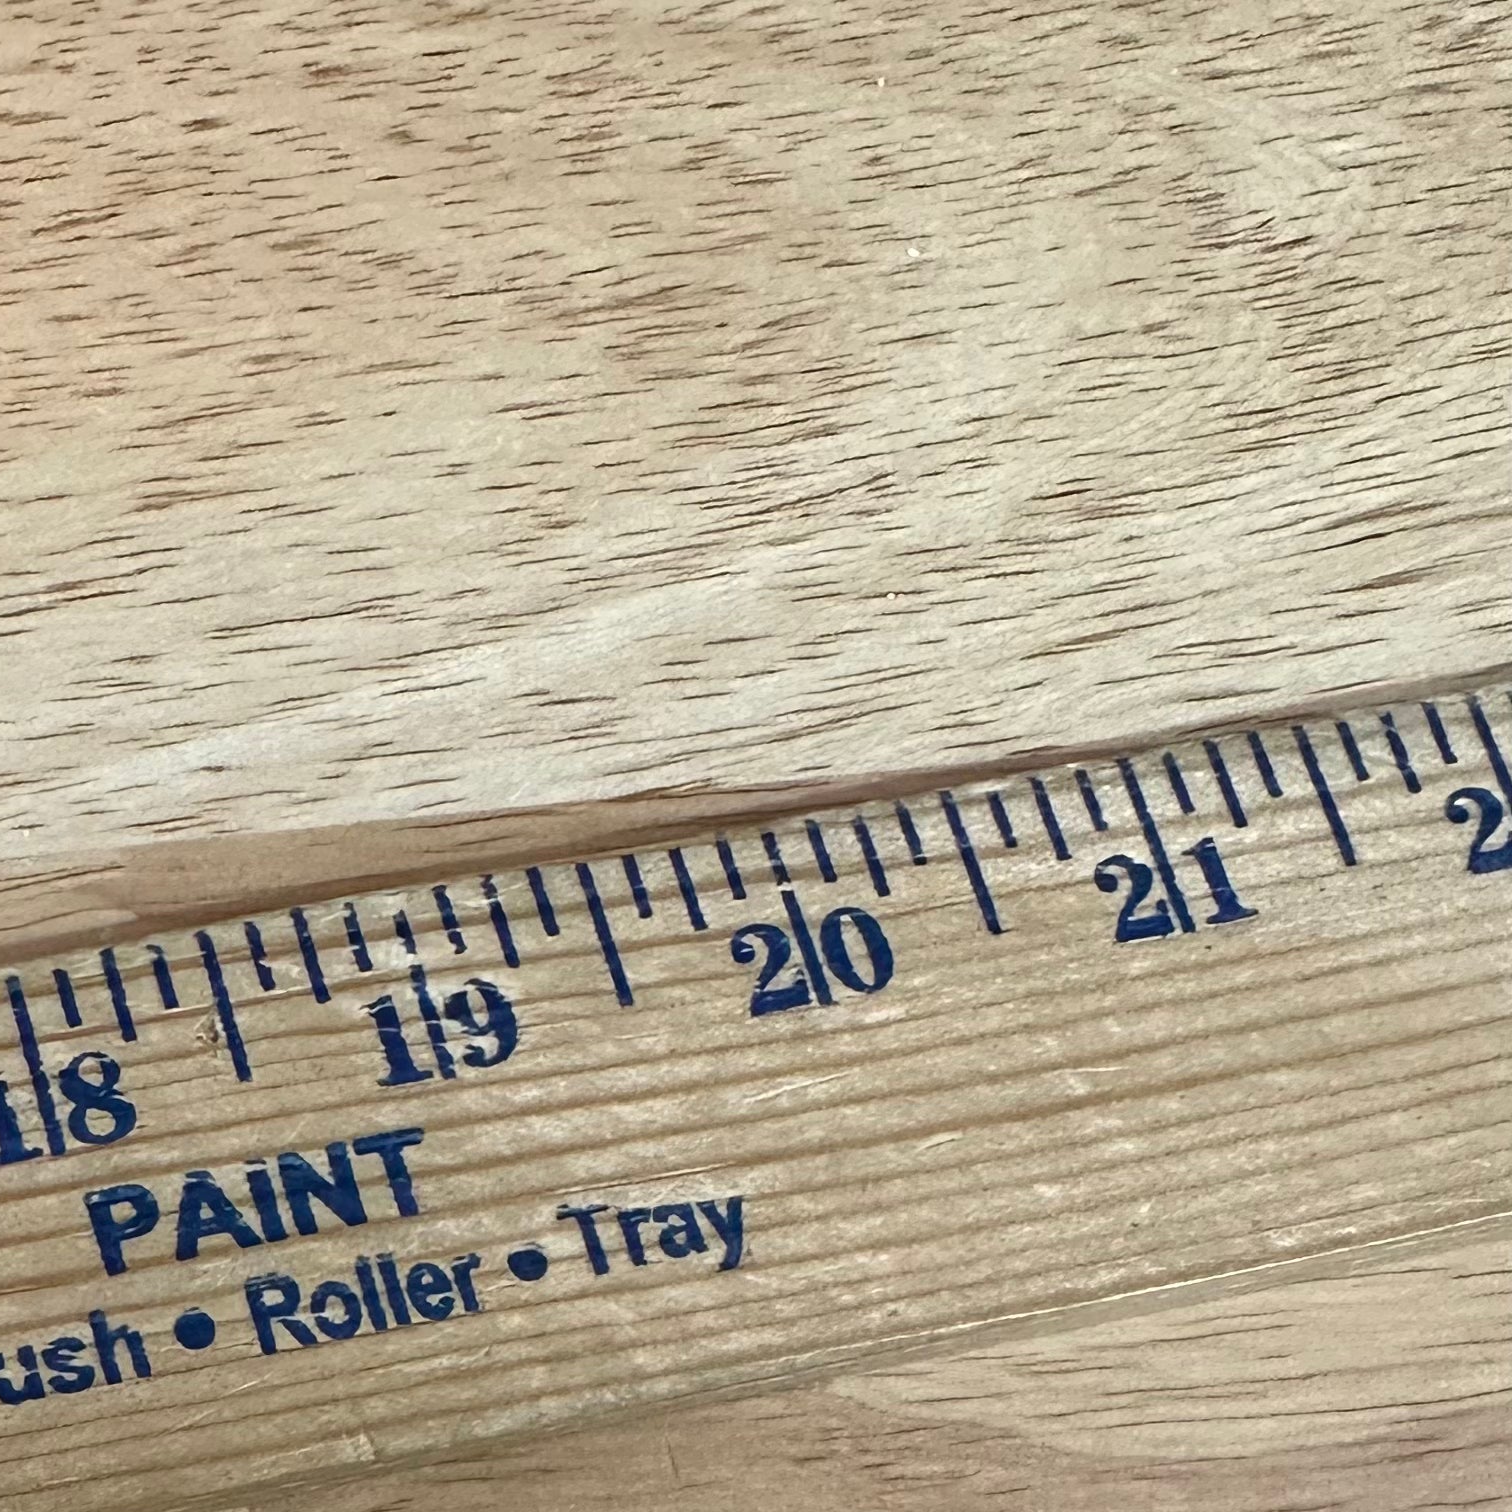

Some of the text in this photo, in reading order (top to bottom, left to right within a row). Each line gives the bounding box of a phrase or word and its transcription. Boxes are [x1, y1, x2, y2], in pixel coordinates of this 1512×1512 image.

[360, 978, 520, 1087] 19
[731, 906, 894, 1017] 20
[1093, 837, 1259, 943] 21
[83, 1127, 425, 1276] PAINT
[243, 1252, 482, 1355] Roller
[557, 1196, 745, 1275] Tray
